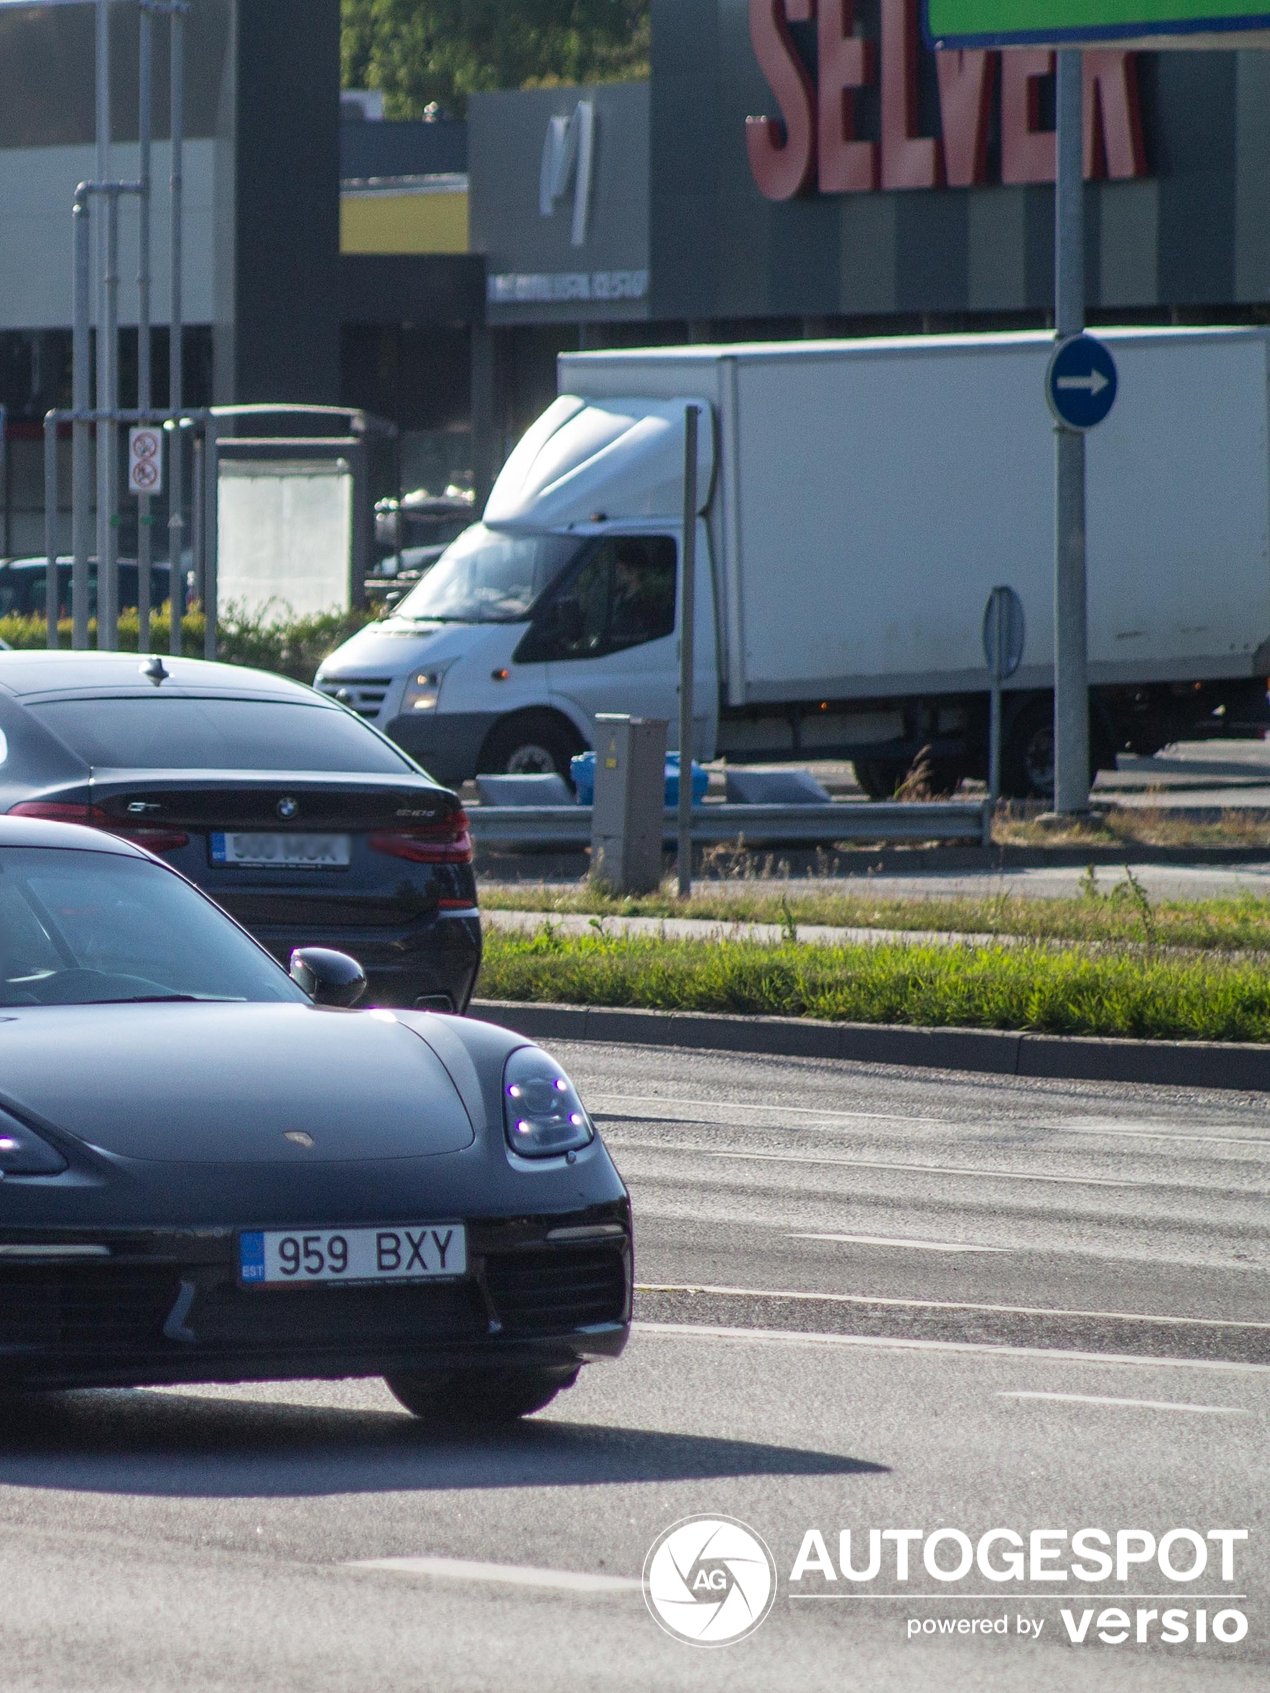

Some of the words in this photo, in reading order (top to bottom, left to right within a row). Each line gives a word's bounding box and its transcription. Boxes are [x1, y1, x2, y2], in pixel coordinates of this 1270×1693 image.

[278, 1235, 348, 1276] 959
[376, 1230, 453, 1271] BXY
[242, 1265, 264, 1277] EST
